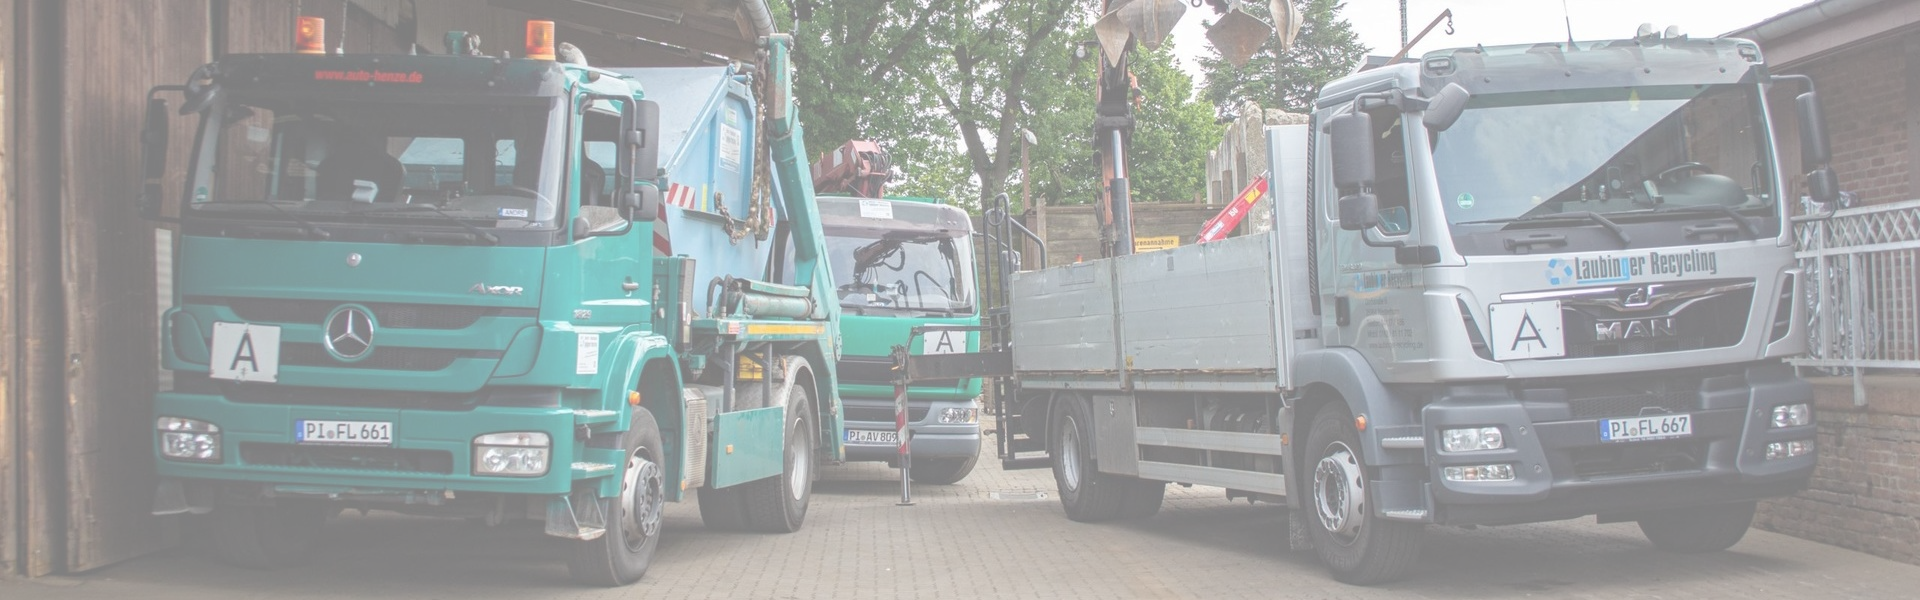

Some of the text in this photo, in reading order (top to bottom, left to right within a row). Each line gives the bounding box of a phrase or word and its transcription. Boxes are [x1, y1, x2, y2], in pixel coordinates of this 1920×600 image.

[315, 69, 422, 83] www.auto-henze.de
[1575, 249, 1718, 282] Laubinger Recycling
[1511, 309, 1547, 351] A
[1595, 318, 1677, 341] MAN
[230, 332, 259, 372] A
[935, 330, 954, 352] A
[306, 423, 390, 440] PI FL 661
[849, 431, 899, 442] PI AV 809
[1610, 421, 1629, 437] PI
[1639, 419, 1658, 435] FL
[1661, 416, 1688, 434] 667
